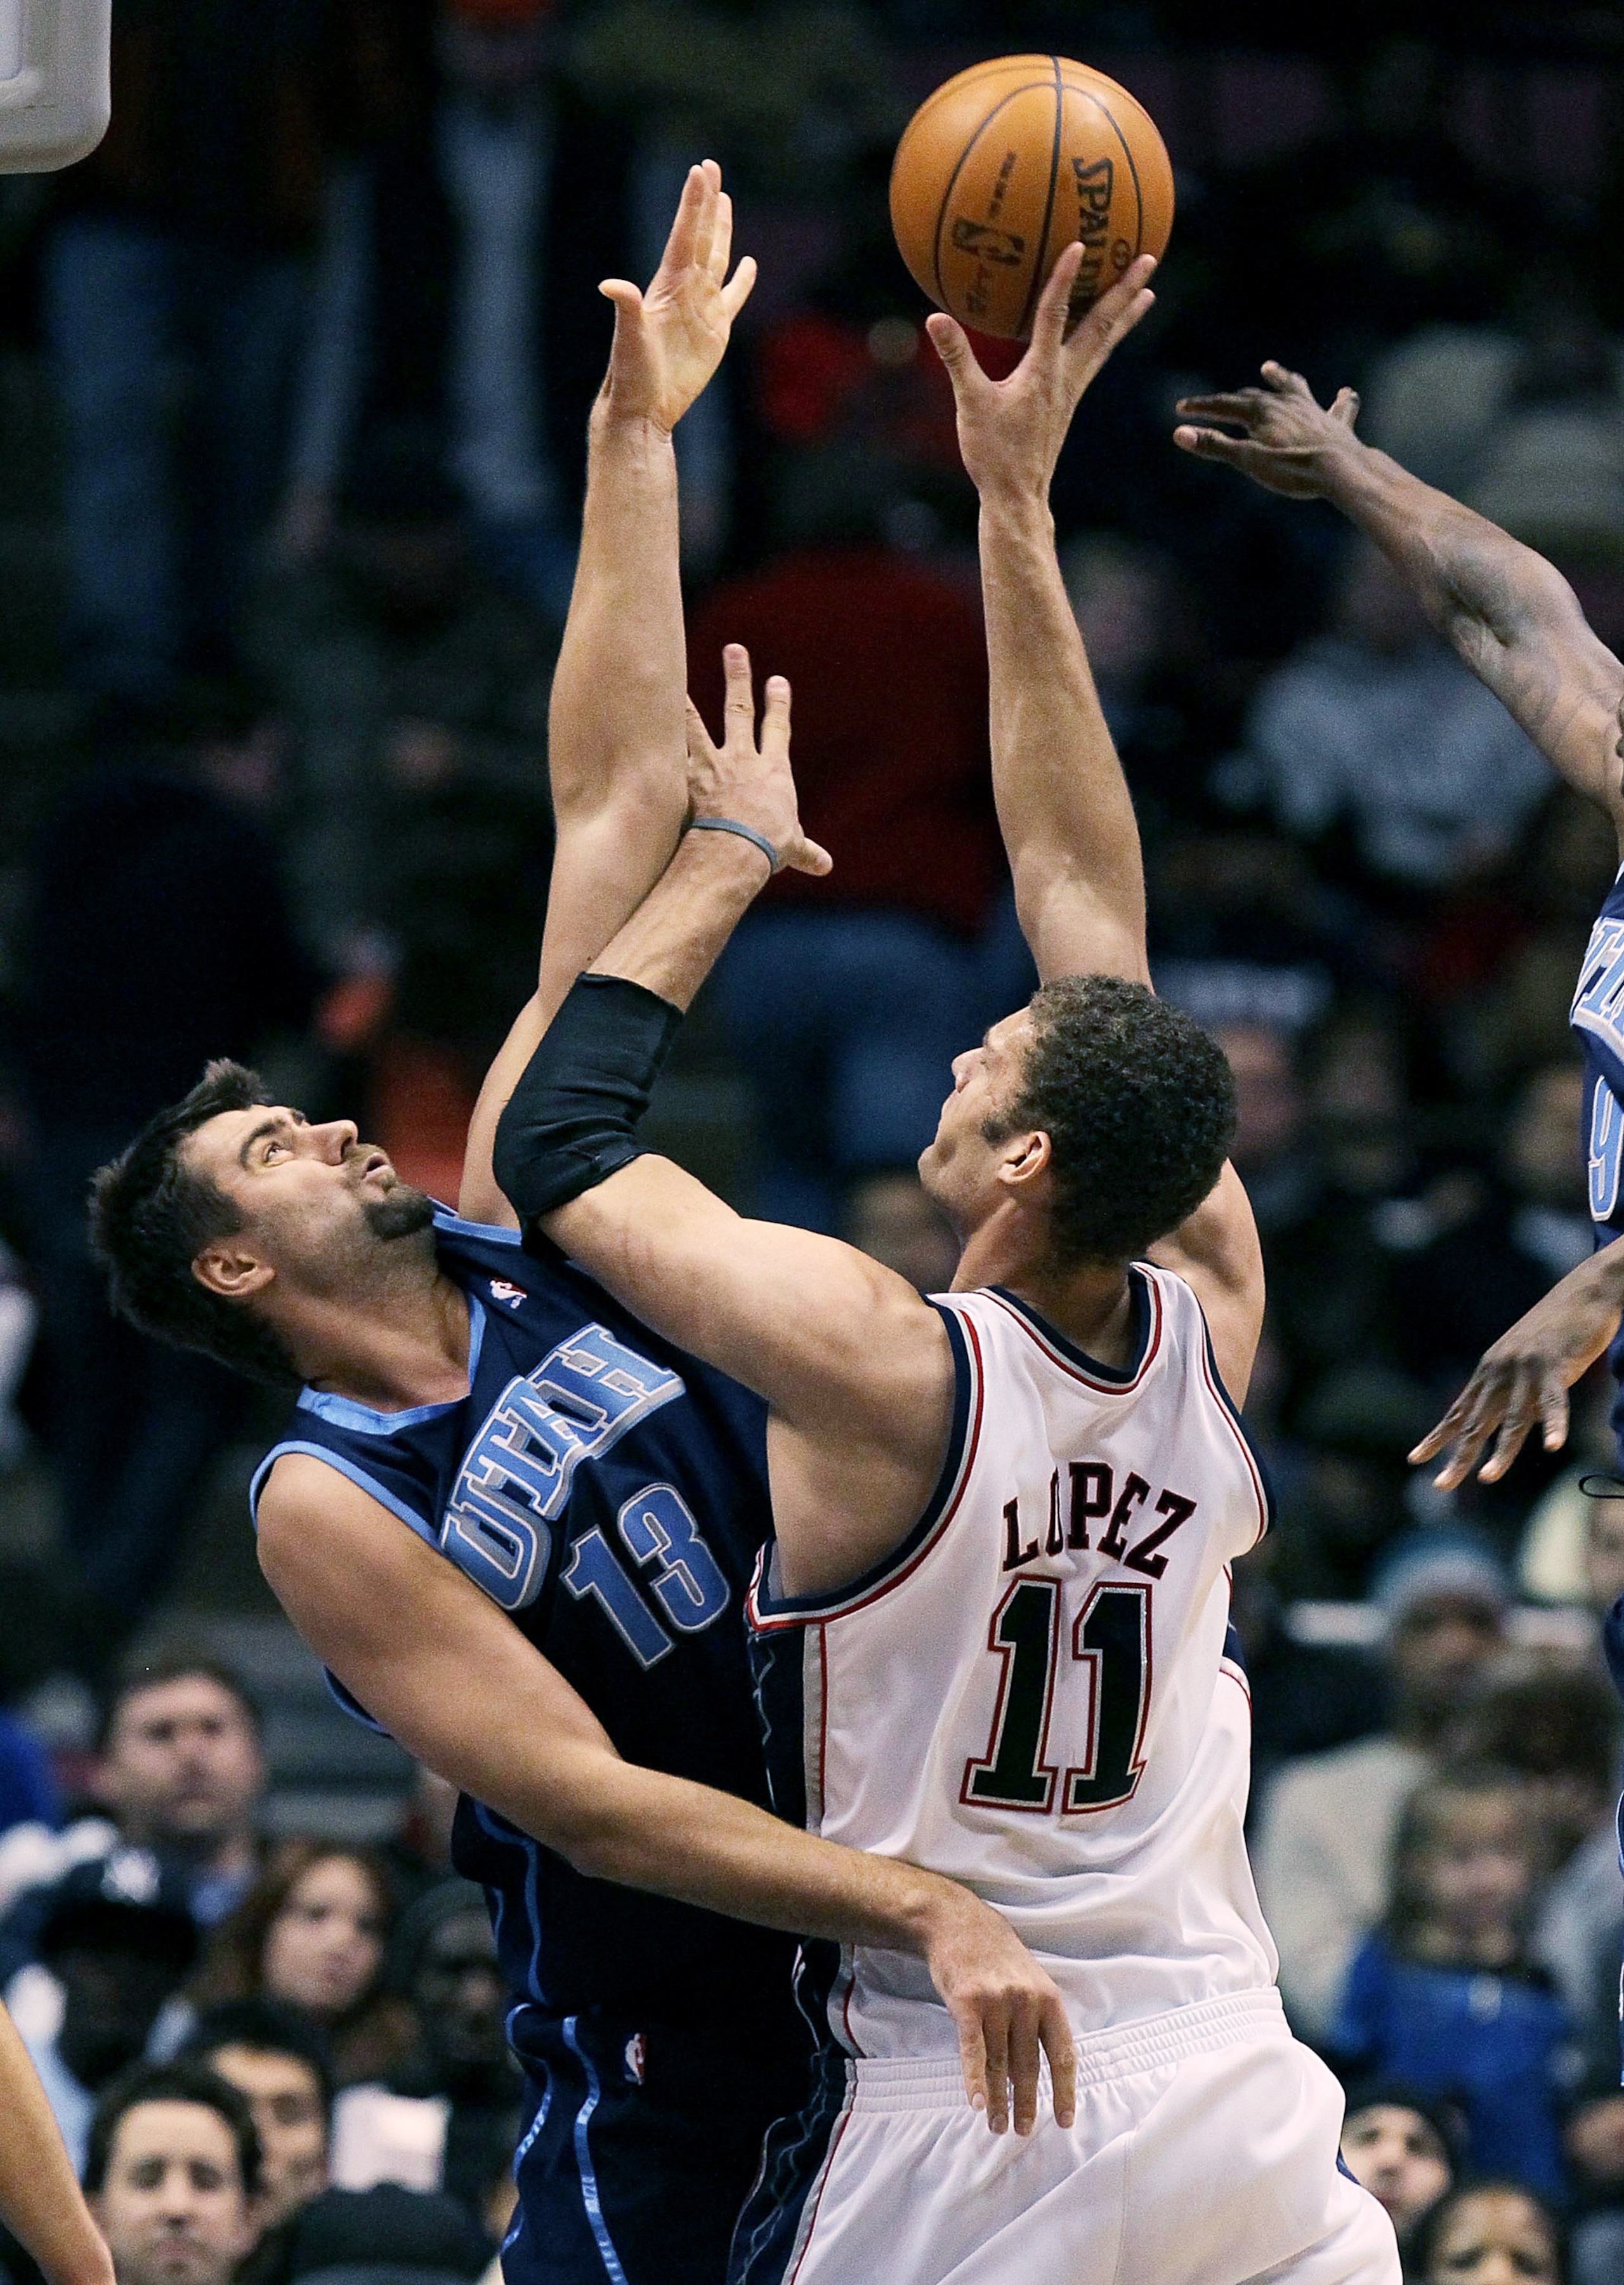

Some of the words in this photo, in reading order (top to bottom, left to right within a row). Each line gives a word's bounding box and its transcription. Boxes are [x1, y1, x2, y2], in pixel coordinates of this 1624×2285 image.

[440, 1322, 686, 1610] UTAH
[1002, 1461, 1197, 1580] LOPEZ
[558, 1482, 732, 1671] 13
[959, 1574, 1153, 1815] 11
